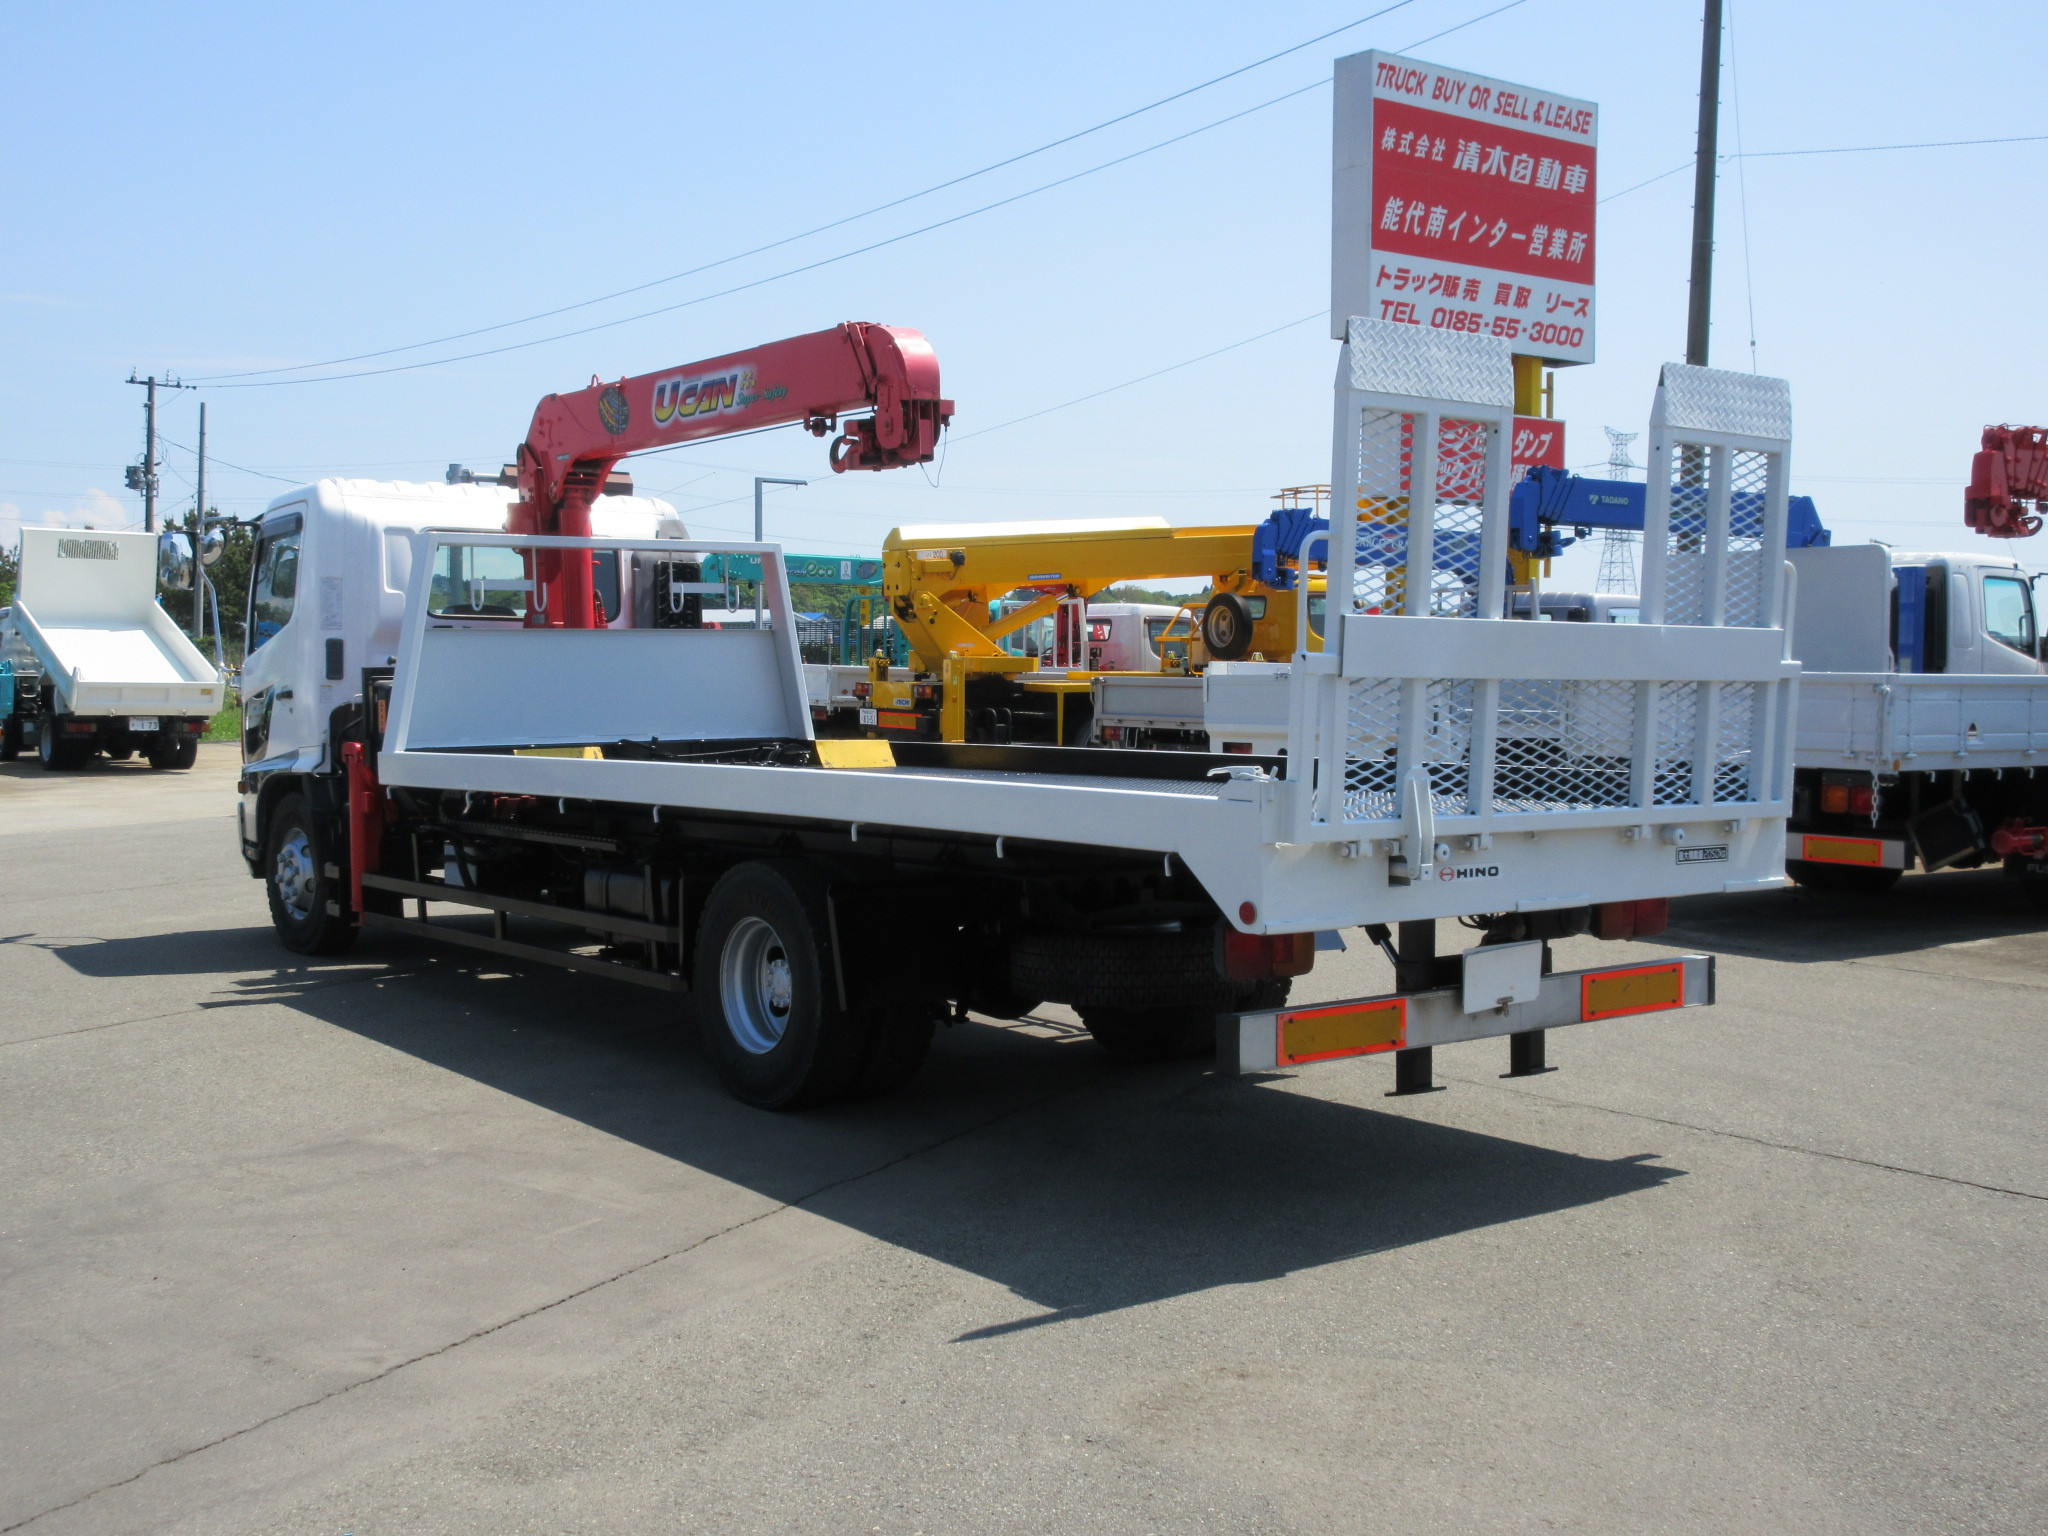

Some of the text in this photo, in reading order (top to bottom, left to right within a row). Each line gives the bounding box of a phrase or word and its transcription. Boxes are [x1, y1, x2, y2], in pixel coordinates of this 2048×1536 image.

[1376, 62, 1427, 96] TRUCK
[1432, 76, 1466, 105] BUY
[1468, 85, 1491, 112] OR
[1493, 91, 1529, 121] SELL
[1544, 103, 1593, 134] LEASE
[1381, 126, 1446, 162] 株式会社
[1380, 196, 1587, 263] 能代南インター営業所
[1376, 265, 1590, 319] トラック販売 買取 リース
[1380, 299, 1421, 326] TEL
[1513, 429, 1553, 458] ダンプ
[1601, 495, 1629, 505] TADANO
[1457, 866, 1499, 878] HINO
